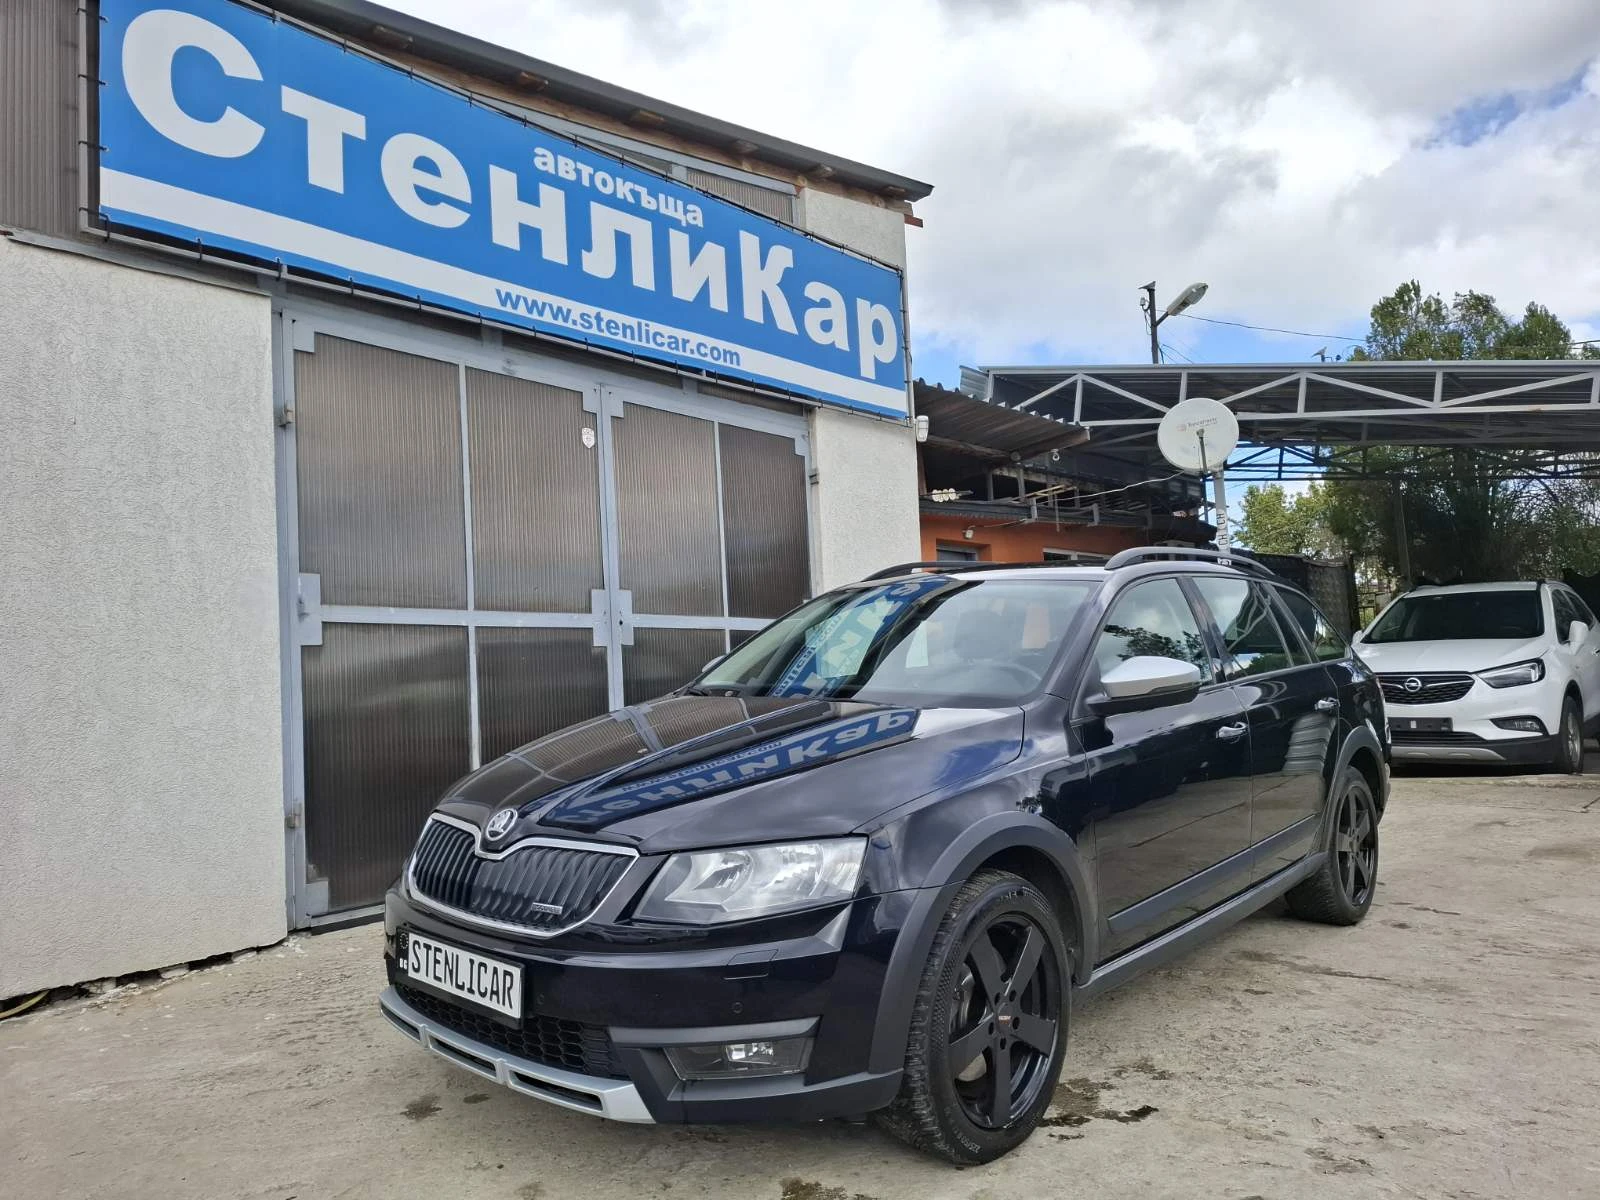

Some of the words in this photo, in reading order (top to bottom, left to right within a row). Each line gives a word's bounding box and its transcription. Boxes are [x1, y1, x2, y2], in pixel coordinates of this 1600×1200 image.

[122, 9, 898, 380] СтенлиКар
[533, 146, 704, 229] автокъща
[495, 288, 741, 367] www.stenlicar.com
[411, 939, 514, 1009] STENLICAR
